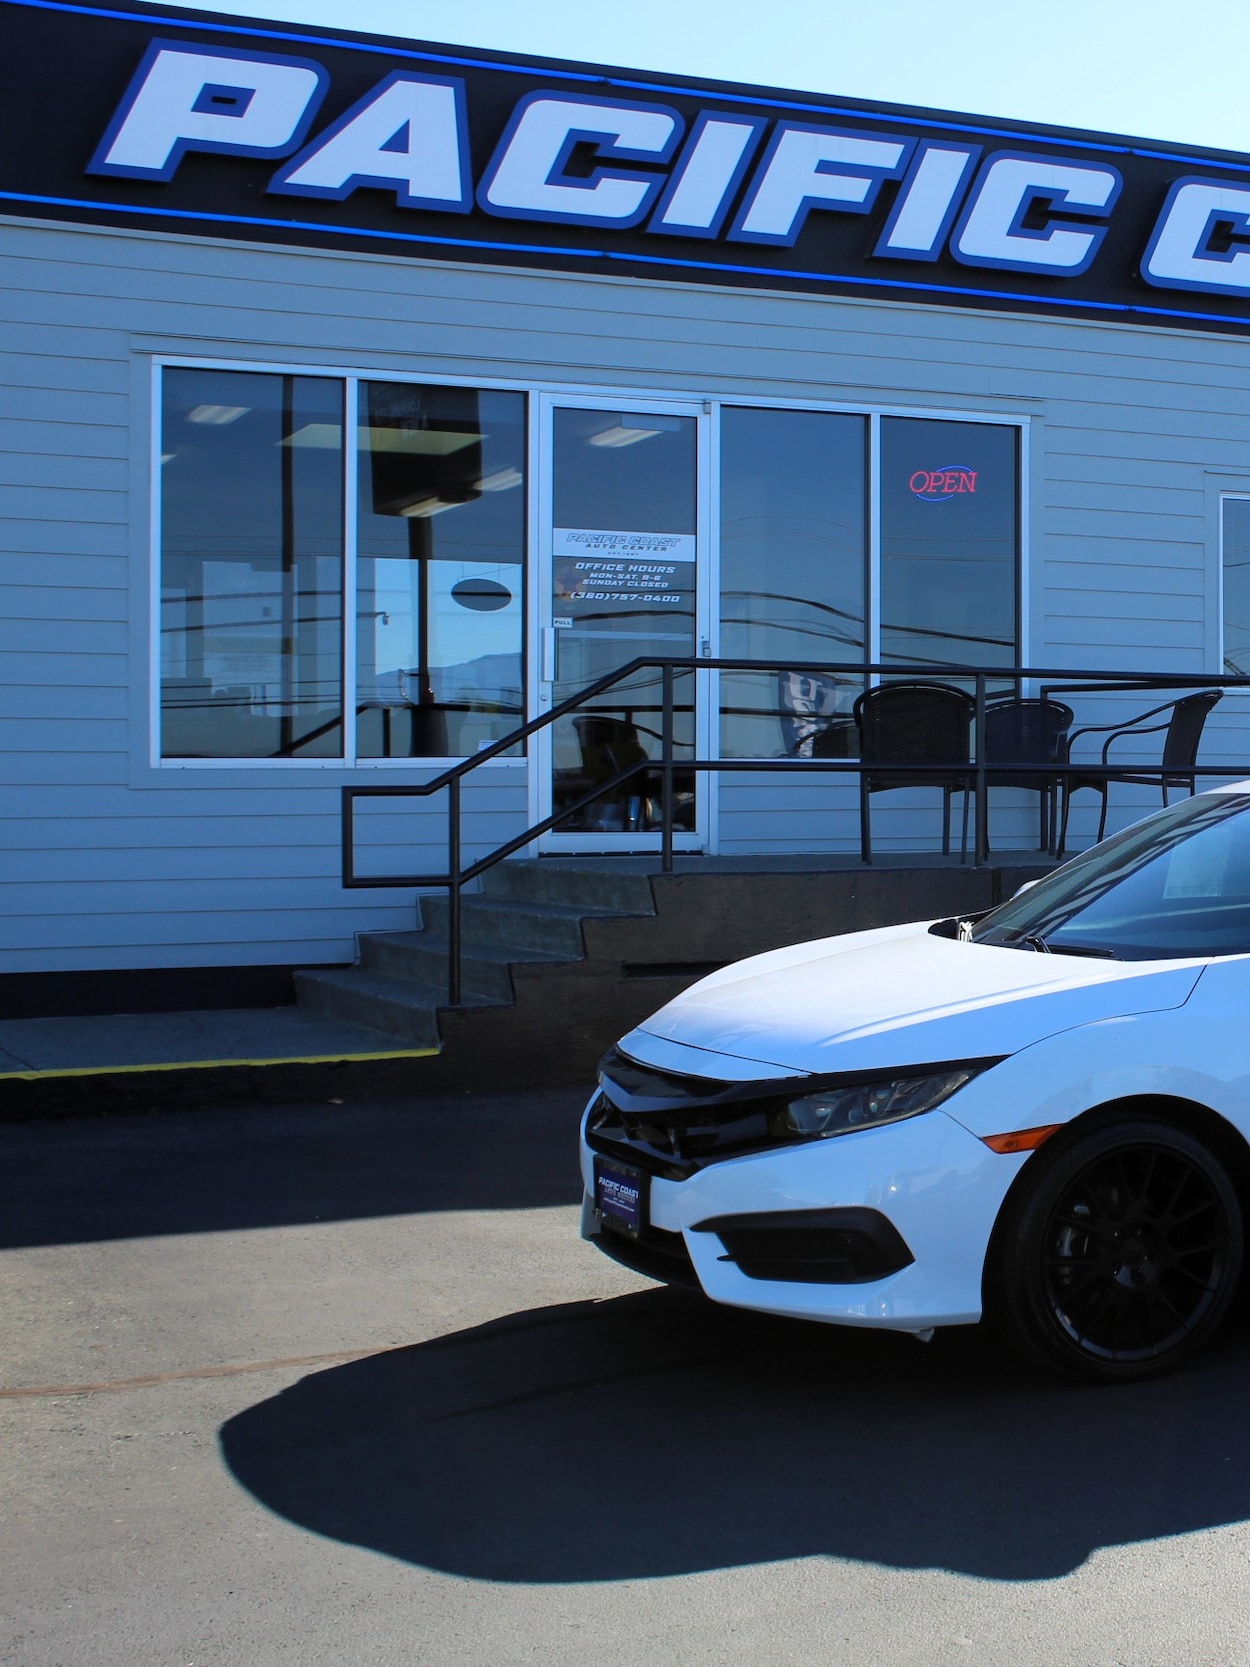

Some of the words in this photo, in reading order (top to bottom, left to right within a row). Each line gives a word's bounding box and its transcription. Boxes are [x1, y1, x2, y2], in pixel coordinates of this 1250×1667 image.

[85, 37, 1123, 276] PACIFIC
[908, 470, 978, 493] OPEN
[566, 533, 628, 545] PACIFIC
[628, 535, 682, 548] COAST
[622, 544, 668, 552] CENTER
[575, 562, 625, 571] OFFICE
[628, 564, 676, 574] HOURS
[589, 572, 639, 580] MON-SAT.
[626, 580, 669, 588] CLOSED
